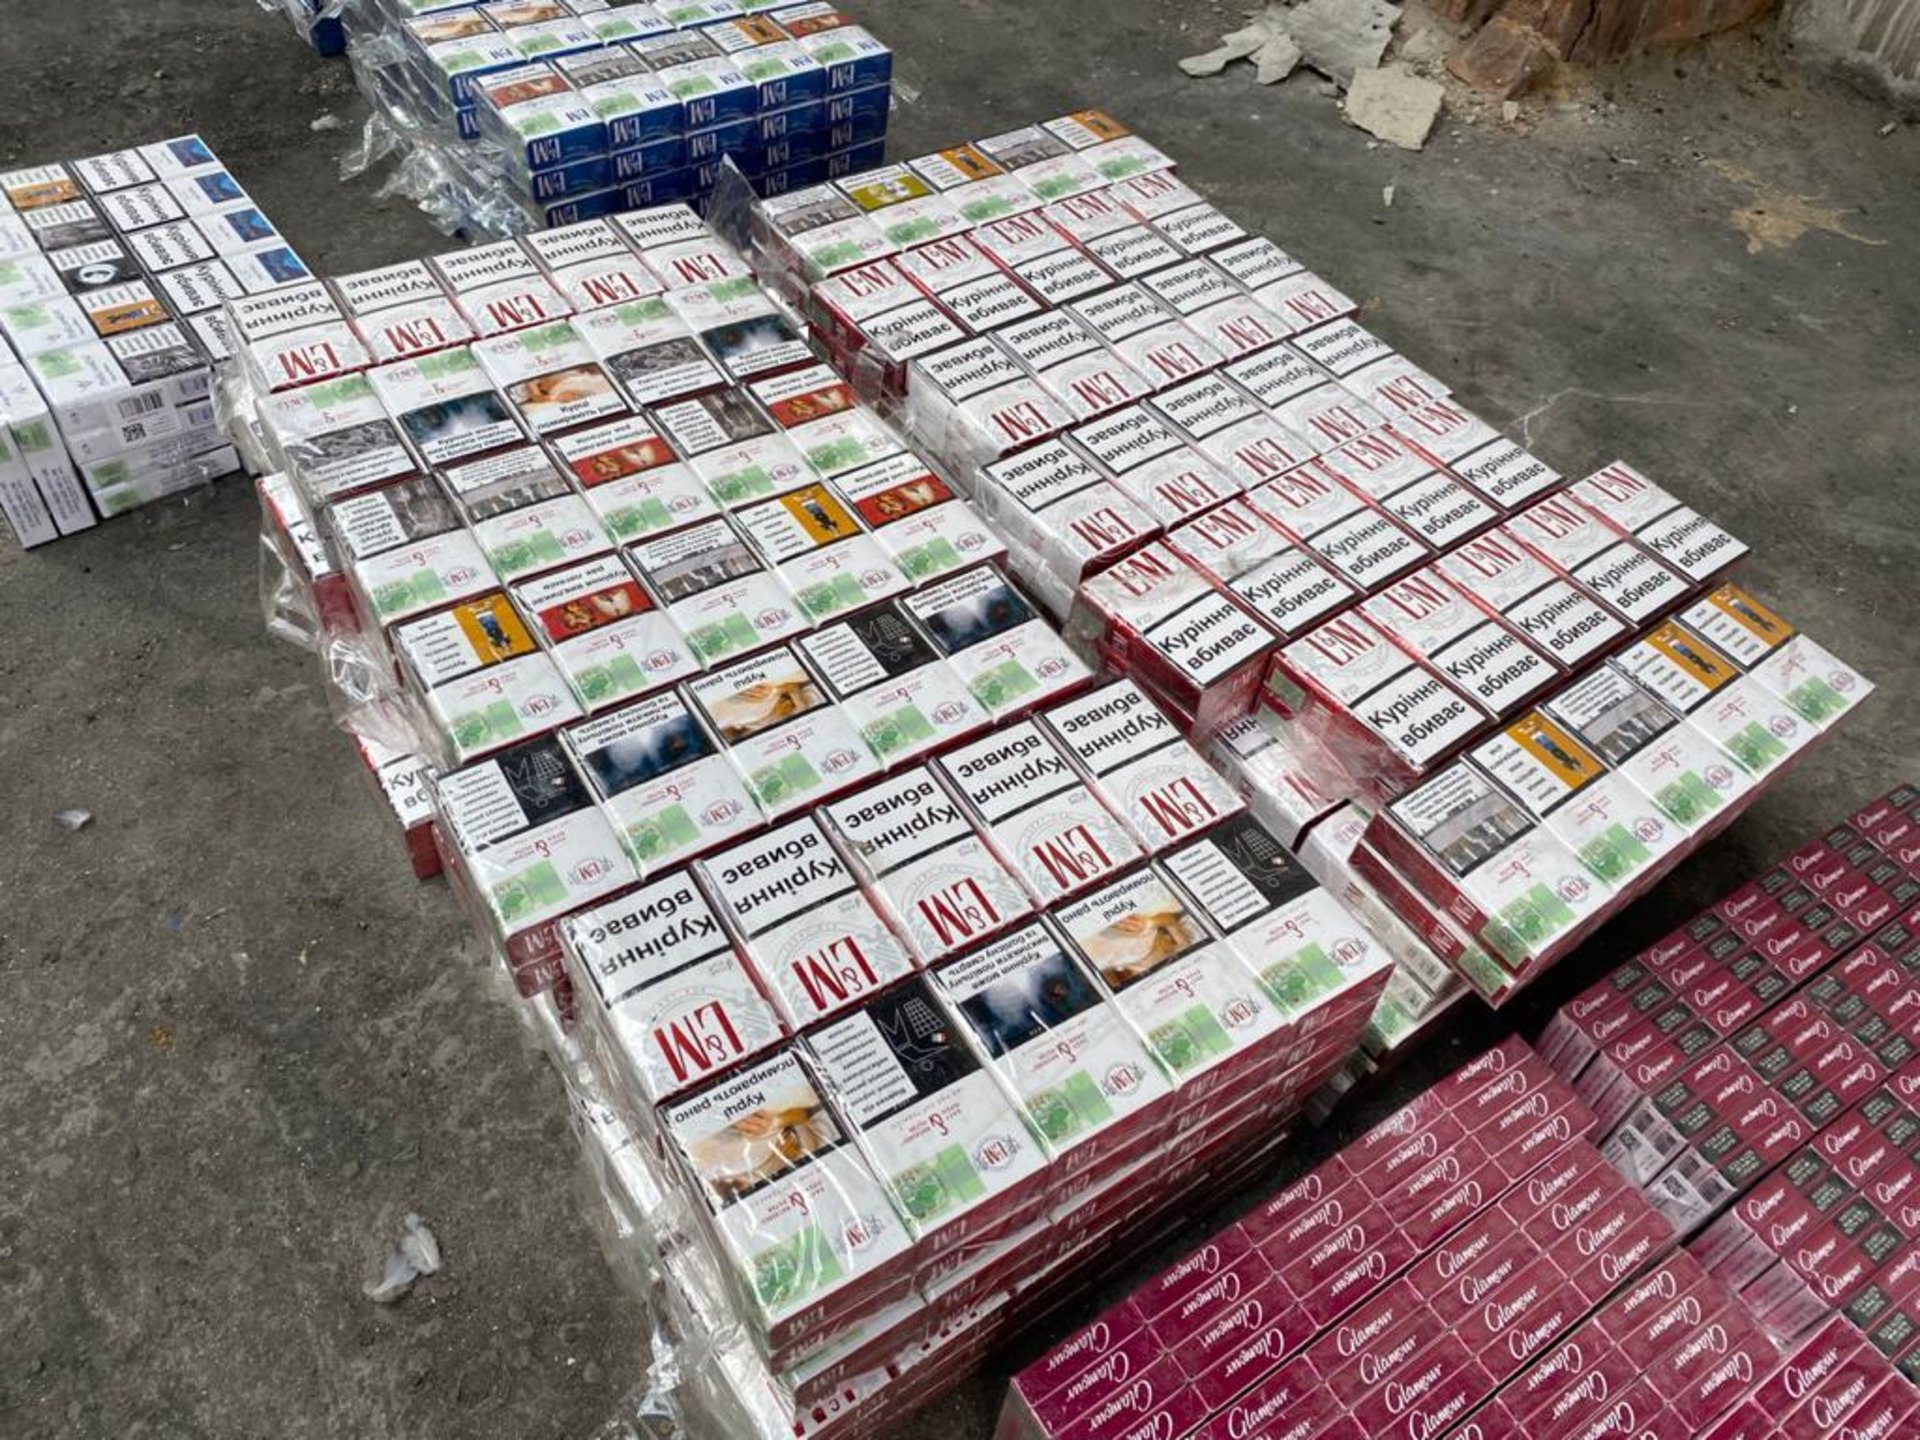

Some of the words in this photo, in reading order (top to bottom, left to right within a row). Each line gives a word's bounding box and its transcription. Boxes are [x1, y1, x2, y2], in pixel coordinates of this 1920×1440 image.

[1126, 172, 1178, 199] L&M
[625, 209, 691, 228] вбиває
[1061, 194, 1113, 221] L&M
[1161, 208, 1219, 234] Куріння
[537, 225, 605, 246] вбиває
[544, 236, 620, 260] Куріння
[634, 221, 706, 241] Куріння
[992, 216, 1044, 245] L&M
[1094, 231, 1157, 259] Куріння
[1181, 221, 1234, 246] вбиває
[444, 246, 516, 268] вбиває
[451, 259, 534, 283] Куріння
[672, 252, 728, 283] L&M
[917, 240, 973, 271] L&M
[1023, 256, 1084, 283] Куріння
[1114, 245, 1170, 270] вбиває
[1223, 242, 1274, 268] вбиває
[1237, 255, 1293, 281] Куріння
[346, 267, 423, 290] вбиває
[351, 279, 440, 305] Куріння
[582, 272, 639, 304] L&M
[840, 265, 895, 297] L&M
[946, 281, 1015, 310] Куріння
[1042, 267, 1100, 296] вбиває
[242, 289, 323, 314] вбиває
[245, 304, 336, 330] Куріння
[487, 294, 547, 328] L&M
[967, 293, 1028, 322] вбиває
[1084, 291, 1142, 318] вбиває
[1098, 303, 1162, 333] Куріння
[1285, 290, 1340, 323] L&M
[384, 318, 446, 352] L&M
[868, 307, 939, 338] Куріння
[1306, 325, 1360, 352] вбиває
[279, 341, 340, 379] L&M
[931, 345, 995, 374] вбиває
[1146, 342, 1204, 379] L&M
[1322, 339, 1383, 367] Куріння
[944, 361, 1016, 391] Куріння
[1377, 374, 1435, 412] L&M
[1165, 381, 1225, 412] вбиває
[1181, 394, 1247, 428] Куріння
[991, 401, 1053, 441] L&M
[1409, 401, 1469, 436] L&M
[1002, 448, 1068, 482] вбиває
[1234, 437, 1296, 477] L&M
[1340, 434, 1402, 472] L&M
[1463, 447, 1525, 483] Куріння
[1016, 462, 1093, 500] Куріння
[1267, 470, 1330, 508] L&M
[1490, 463, 1545, 497] вбиває
[1587, 466, 1648, 504] L&M
[1396, 483, 1458, 521] Куріння
[1422, 500, 1480, 536] вбиває
[1523, 500, 1587, 540] L&M
[1070, 507, 1136, 552] L&M
[1190, 507, 1256, 550] L&M
[1320, 519, 1390, 561] Куріння
[1650, 516, 1708, 554] Куріння
[1348, 537, 1411, 576] вбиває
[1455, 536, 1522, 579] L&M
[1678, 533, 1732, 569] вбиває
[1107, 551, 1175, 597] L&M
[1242, 560, 1316, 603] Куріння
[1586, 552, 1647, 594] Куріння
[1615, 571, 1672, 610] вбиває
[1271, 580, 1336, 619] вбиває
[1382, 575, 1452, 621] L&M
[1519, 592, 1586, 635] Куріння
[1158, 603, 1238, 654] Куріння
[1187, 623, 1258, 671] вбиває
[1305, 619, 1376, 668] L&M
[1548, 610, 1608, 652] вбиває
[1446, 634, 1518, 680] Куріння
[1477, 654, 1539, 699] вбиває
[1063, 691, 1141, 733] вбиває
[1368, 679, 1444, 731] Куріння
[1077, 711, 1167, 759] Куріння
[1401, 700, 1466, 749] вбиває
[959, 734, 1040, 777] вбиває
[972, 756, 1067, 805] Куріння
[844, 781, 934, 828] вбиває
[1139, 776, 1217, 837] L&M
[861, 804, 960, 856] Куріння
[722, 833, 818, 884] вбиває
[1032, 824, 1112, 889] L&M
[733, 857, 843, 915] Куріння
[590, 889, 693, 943] вбиває
[917, 877, 1001, 947] L&M
[1061, 902, 1091, 924] рано
[1102, 901, 1137, 921] Курці
[600, 915, 717, 976] Куріння
[792, 936, 879, 1011] L&M
[653, 1000, 745, 1083] L&M
[1457, 1048, 1505, 1084] Glamour
[675, 1097, 712, 1123] рано
[723, 1092, 767, 1120] Курці
[1500, 1093, 1548, 1130] Glamour
[1386, 1132, 1437, 1173] Glamour
[1267, 1174, 1321, 1217] Glamour
[1430, 1180, 1481, 1223] Glamour
[1528, 1164, 1578, 1206] Glamour
[1310, 1224, 1365, 1269] Glamour
[1576, 1212, 1627, 1256] Glamour
[1161, 1245, 1220, 1291] Glamour
[1436, 1233, 1490, 1279] Glamour
[1484, 1286, 1538, 1332] Glamour
[1624, 1270, 1677, 1314] Glamour
[1202, 1299, 1263, 1348] Glamour
[1337, 1308, 1394, 1356] Glamour
[1047, 1322, 1110, 1372] Glamour
[1675, 1324, 1728, 1370] Glamour
[1067, 1351, 1130, 1402] Glamour
[1385, 1364, 1443, 1414] Glamour
[1784, 1348, 1839, 1398] Glamour
[1088, 1379, 1152, 1432] Glamour
[1812, 1375, 1866, 1428] Glamour
